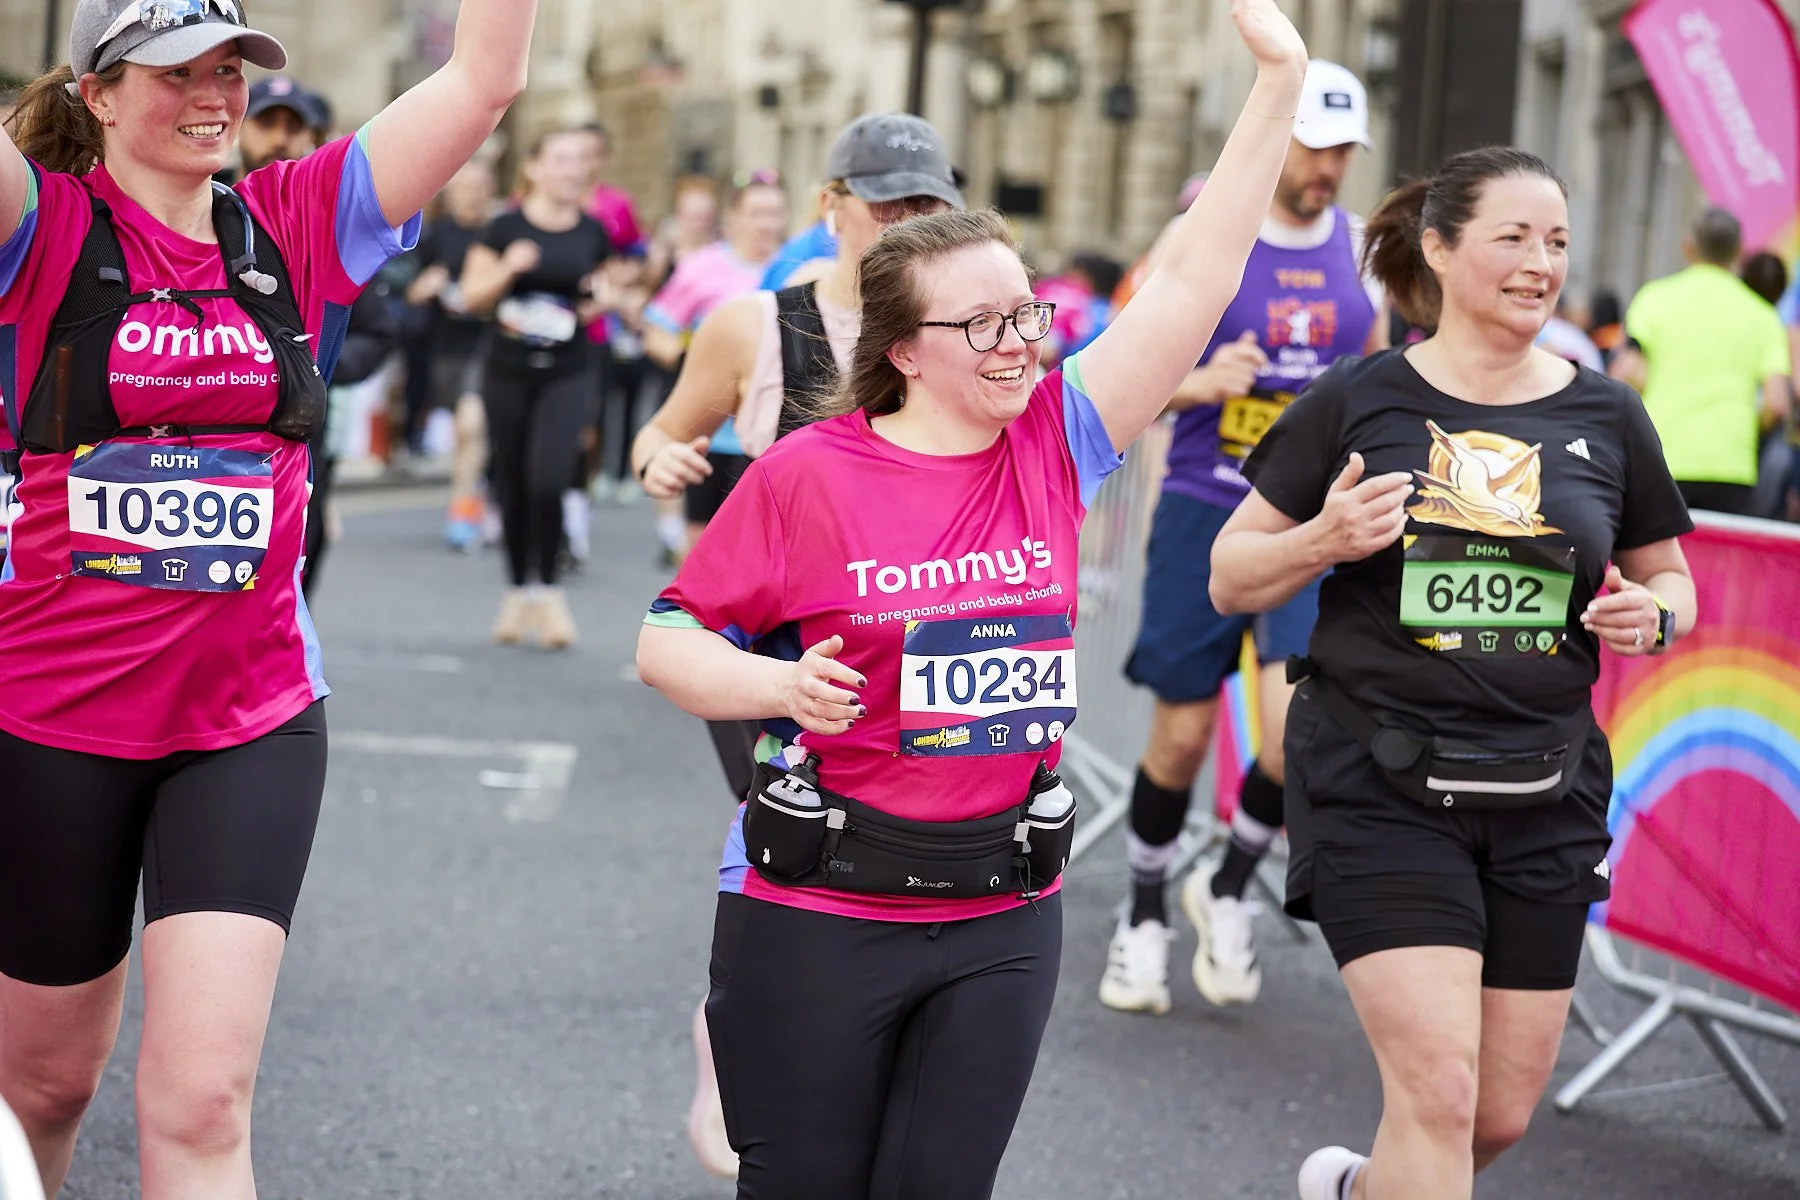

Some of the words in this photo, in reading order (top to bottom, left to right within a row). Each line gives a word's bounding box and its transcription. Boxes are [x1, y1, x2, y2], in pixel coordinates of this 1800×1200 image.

[117, 313, 275, 364] ommy
[109, 371, 192, 389] pregnancy
[196, 371, 226, 386] and
[230, 371, 268, 387] baby
[150, 453, 199, 469] RUTH
[85, 486, 260, 541] 10396
[846, 536, 1052, 597] Tommy's
[1466, 544, 1510, 558] EMMA
[850, 614, 874, 626] The
[878, 603, 955, 624] pregnancy
[959, 597, 986, 612] and
[988, 592, 1023, 608] baby
[1025, 582, 1063, 602] charity
[1427, 574, 1543, 614] 6492
[970, 624, 1017, 638] ANNA
[915, 655, 1066, 706] 10234
